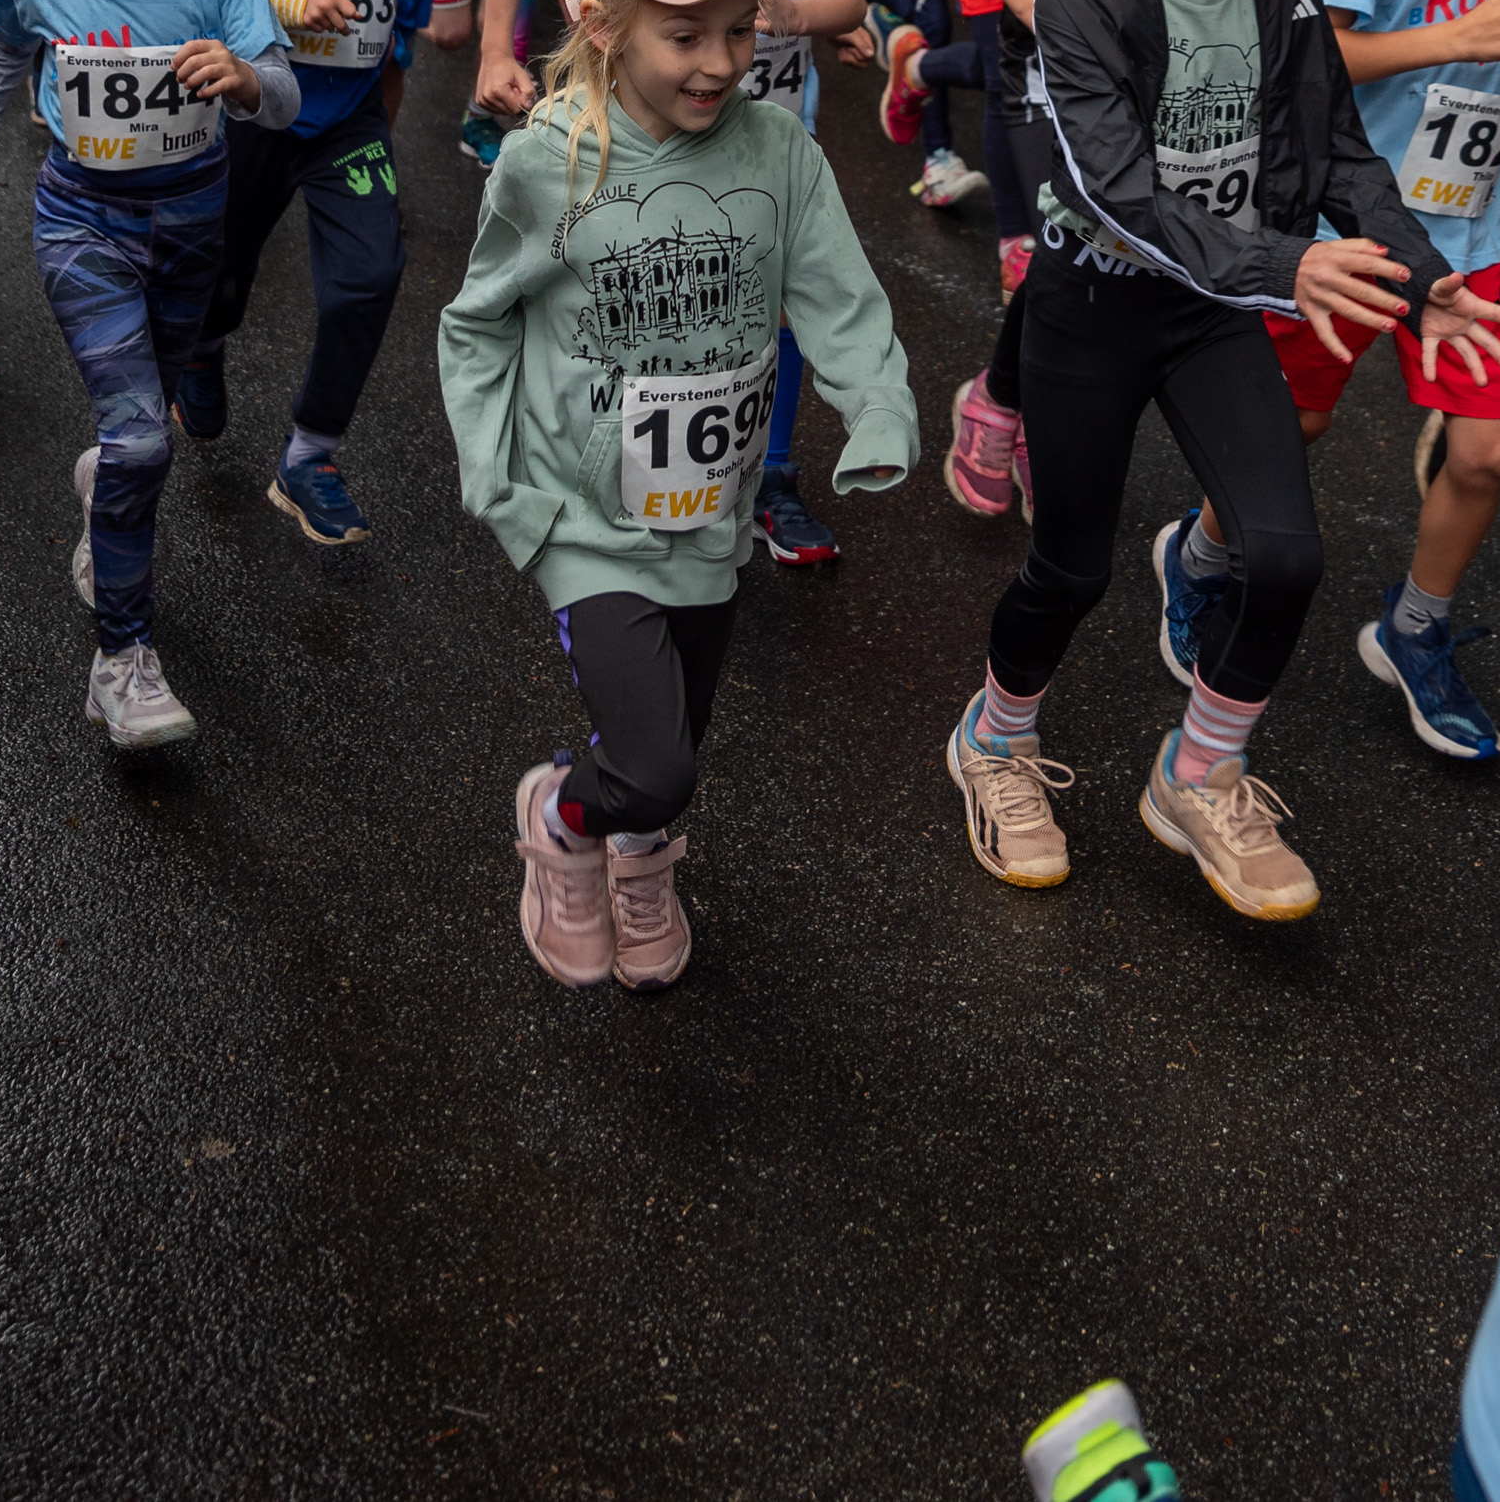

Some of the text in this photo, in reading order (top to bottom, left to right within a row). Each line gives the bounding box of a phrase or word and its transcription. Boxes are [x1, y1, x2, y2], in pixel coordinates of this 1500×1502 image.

[66, 55, 173, 68] Everstener Brun
[129, 122, 159, 133] Mira
[162, 126, 208, 152] bruns
[77, 135, 138, 160] EWE
[365, 146, 387, 161] REX
[1156, 148, 1260, 174] erstener Brunne
[1409, 176, 1476, 208] EWE
[550, 183, 638, 260] GRUNDSCHULE
[638, 385, 730, 403] Everstener
[633, 367, 777, 470] 1698
[706, 455, 745, 481] Sophia
[643, 483, 723, 519] EWE
